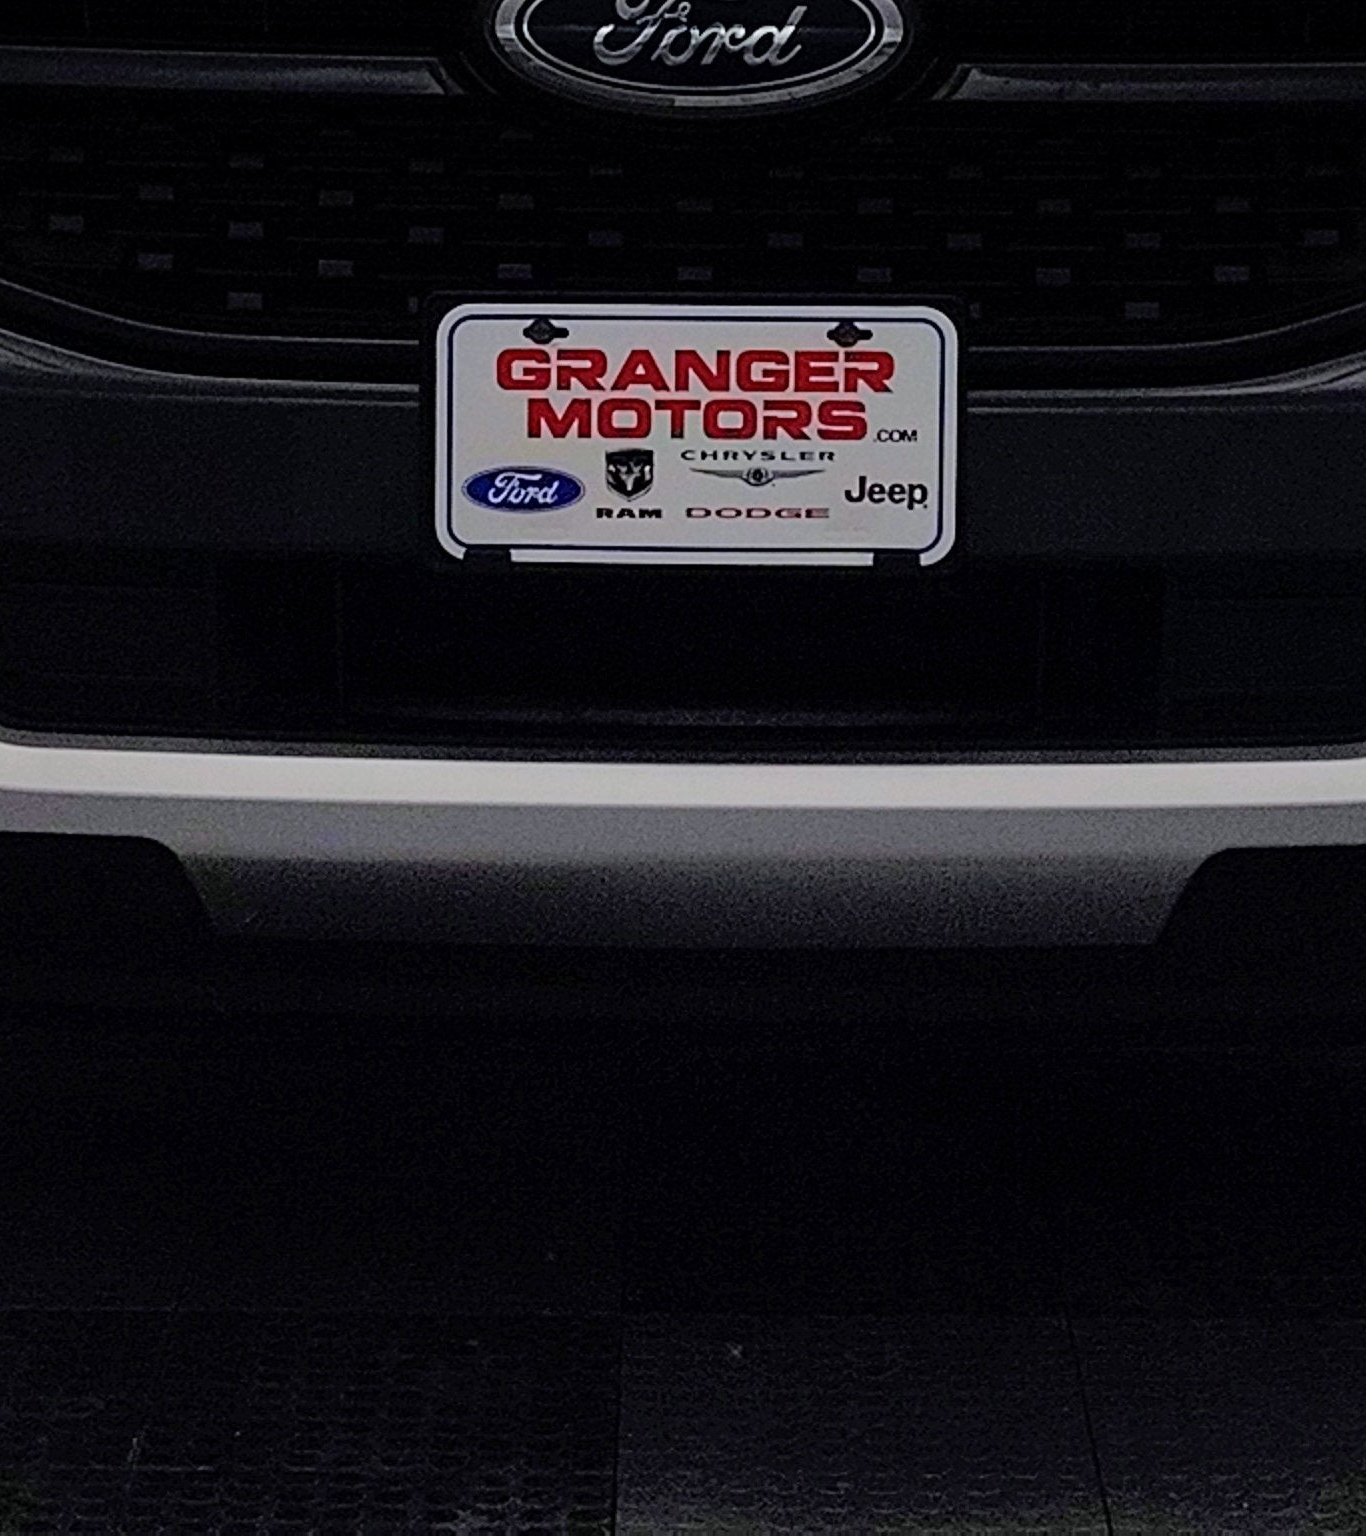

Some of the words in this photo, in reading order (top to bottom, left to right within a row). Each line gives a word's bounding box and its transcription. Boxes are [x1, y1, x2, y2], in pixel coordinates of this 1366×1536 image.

[496, 348, 895, 393] GRANGER
[527, 398, 868, 441] MOTORS
[680, 449, 836, 461] CHRYSLER
[486, 471, 560, 505] Ford
[844, 475, 928, 511] Jeep
[596, 507, 663, 519] RAM
[686, 507, 830, 519] DODGE
